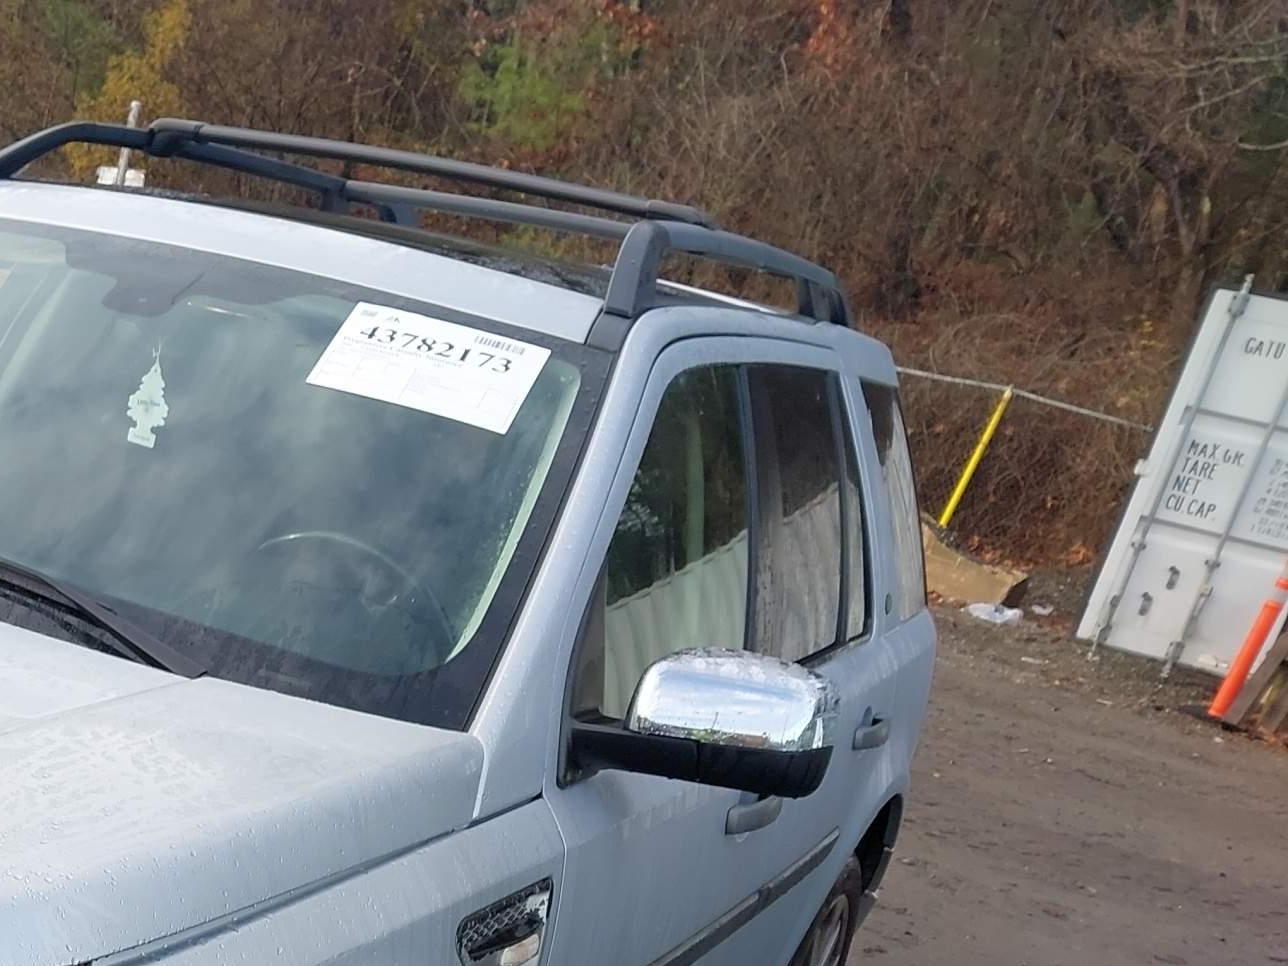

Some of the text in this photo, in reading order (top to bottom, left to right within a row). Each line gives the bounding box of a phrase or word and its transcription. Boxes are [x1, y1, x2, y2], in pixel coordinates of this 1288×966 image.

[359, 325, 513, 374] 43782173
[1244, 336, 1287, 360] GATU
[1182, 456, 1219, 480] TARE
[1172, 474, 1202, 496] NET
